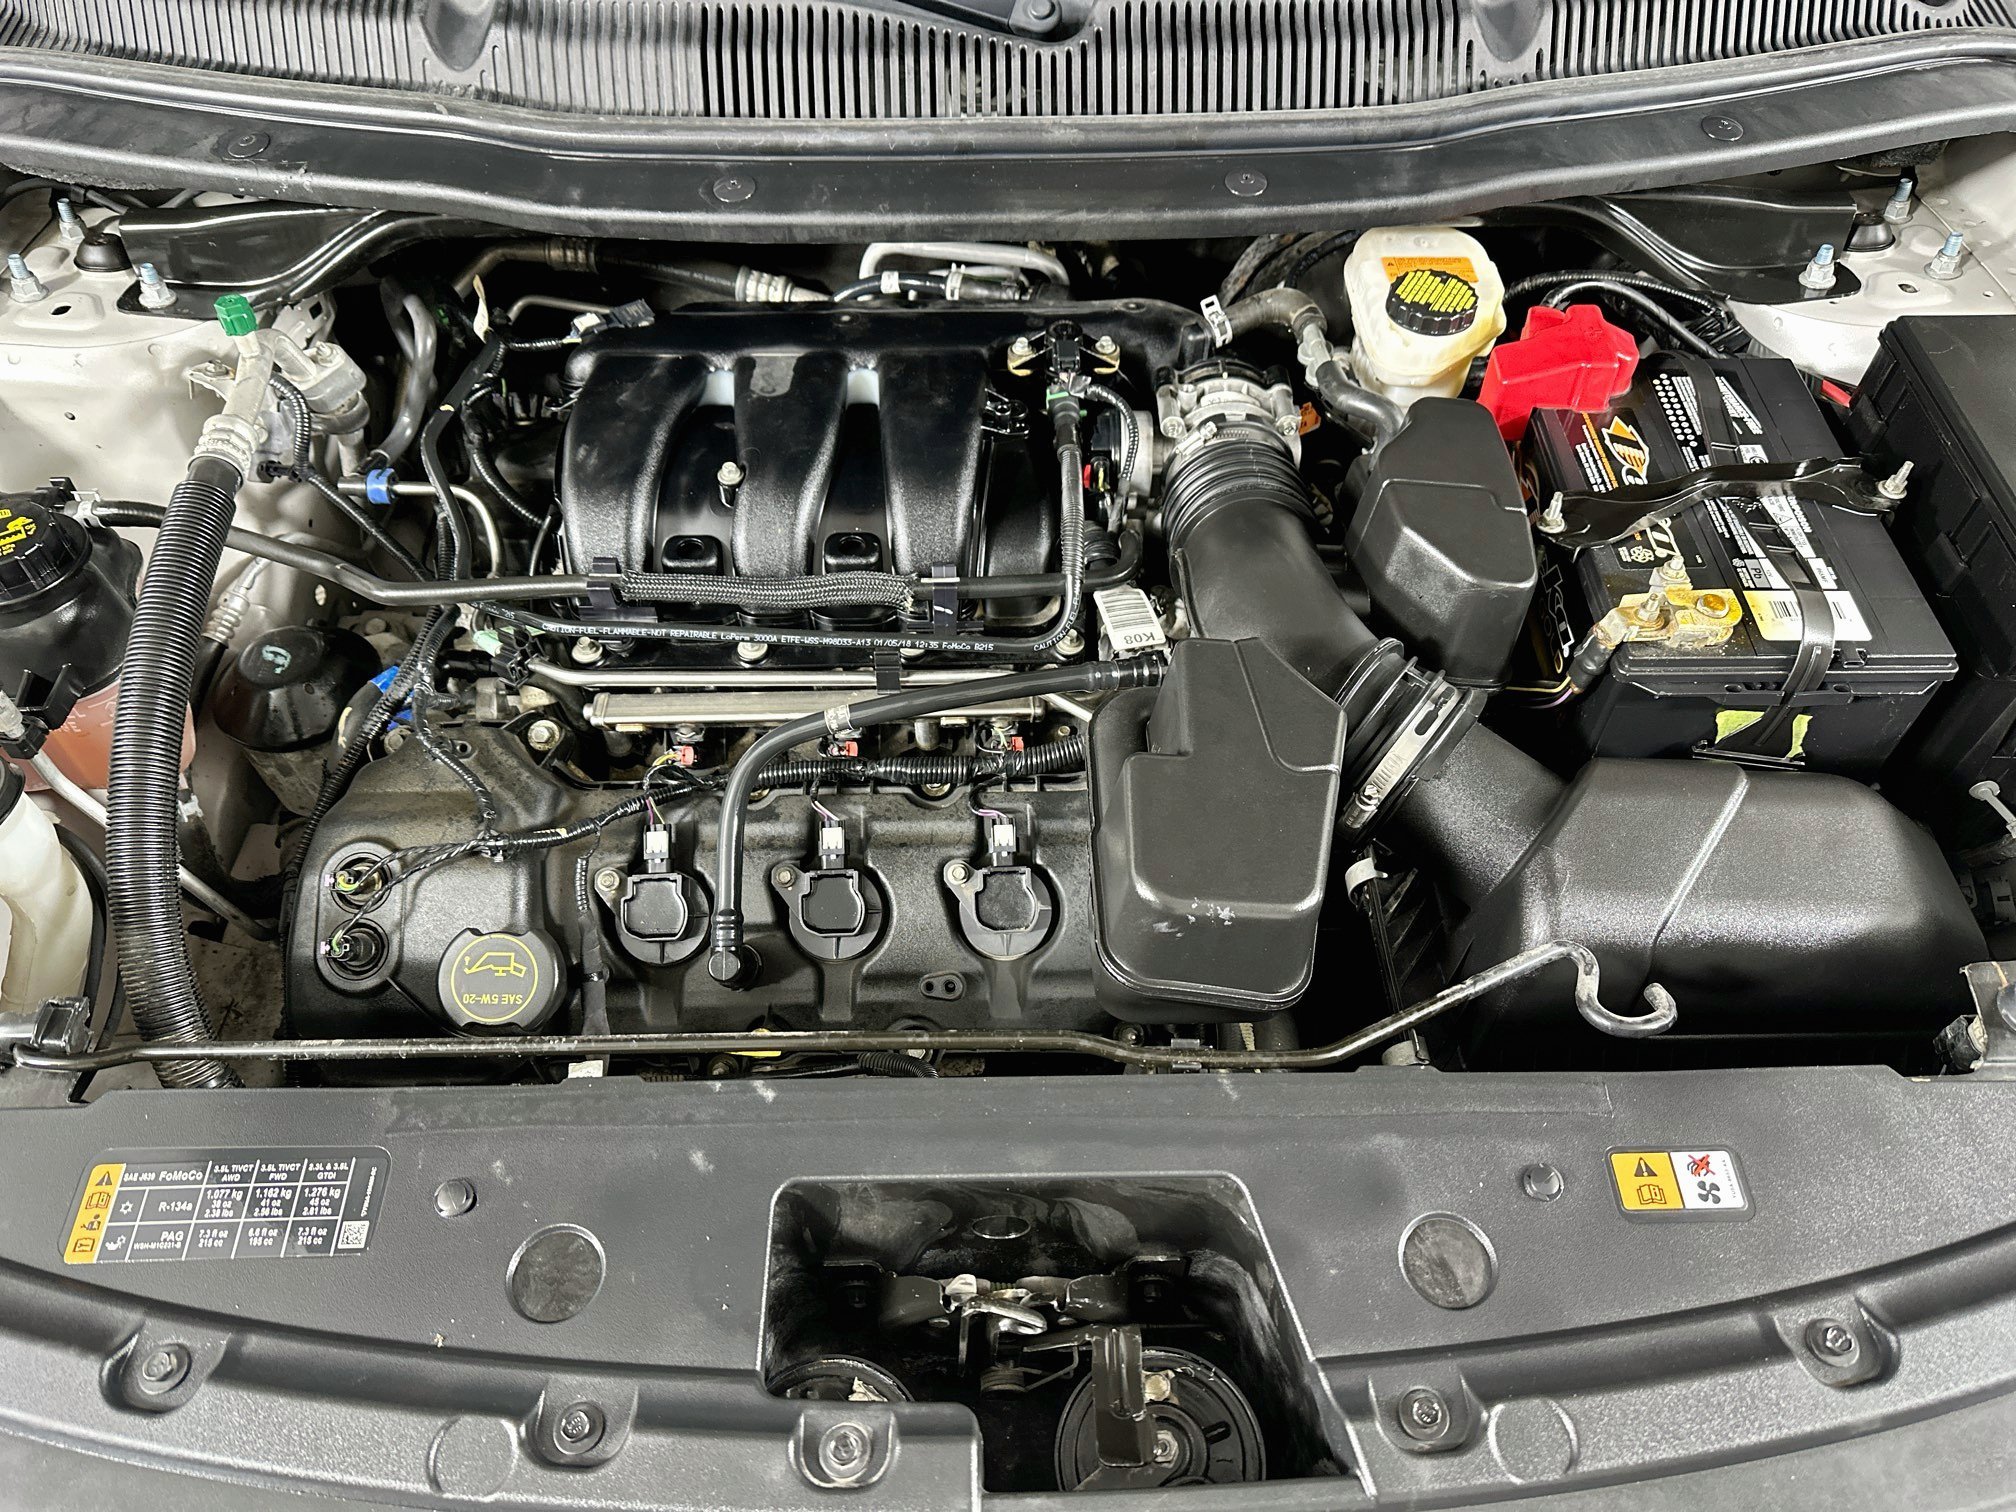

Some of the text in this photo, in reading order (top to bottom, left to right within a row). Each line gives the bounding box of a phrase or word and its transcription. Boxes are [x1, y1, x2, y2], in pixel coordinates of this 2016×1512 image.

[1751, 567, 1763, 579] Pb
[670, 630, 717, 640] REPAIRABLE
[720, 632, 751, 642] LoPerm
[753, 633, 778, 643] 3000A
[781, 635, 872, 647] ETFE-WSS-M98D33-A13
[873, 638, 912, 648] 01/05/18
[914, 640, 939, 649] 12:35
[942, 641, 971, 650] FoMoCo
[1123, 631, 1156, 646] K08
[462, 993, 523, 1005] SAE 5W-20
[213, 1165, 229, 1173] 3.5L
[260, 1164, 276, 1172] 3.5L
[308, 1162, 323, 1171] 2.3L
[333, 1162, 349, 1171] 3.5L
[123, 1173, 139, 1182] SAE
[159, 1170, 203, 1181] FoMoCo
[221, 1173, 241, 1182] AWD
[268, 1172, 287, 1181] FWD
[206, 1188, 243, 1201] 1.077 kg
[255, 1187, 292, 1200] 1.162 kg
[304, 1186, 341, 1199] 1.276 kg
[158, 1201, 193, 1212] R-134a
[211, 1200, 221, 1208] 38
[260, 1199, 270, 1207] 41
[309, 1198, 319, 1206] 45
[204, 1208, 234, 1218] 2.38 lbs
[270, 1207, 283, 1216] lbs
[319, 1206, 332, 1215] lbs
[199, 1228, 228, 1238] 7.3 fl oz
[261, 1227, 268, 1236] fl
[298, 1226, 327, 1236] 7.3 fl oz
[161, 1231, 184, 1241] PAG
[297, 1236, 322, 1245] 215 cc
[198, 1239, 213, 1248] 215
[263, 1238, 273, 1246] cc
